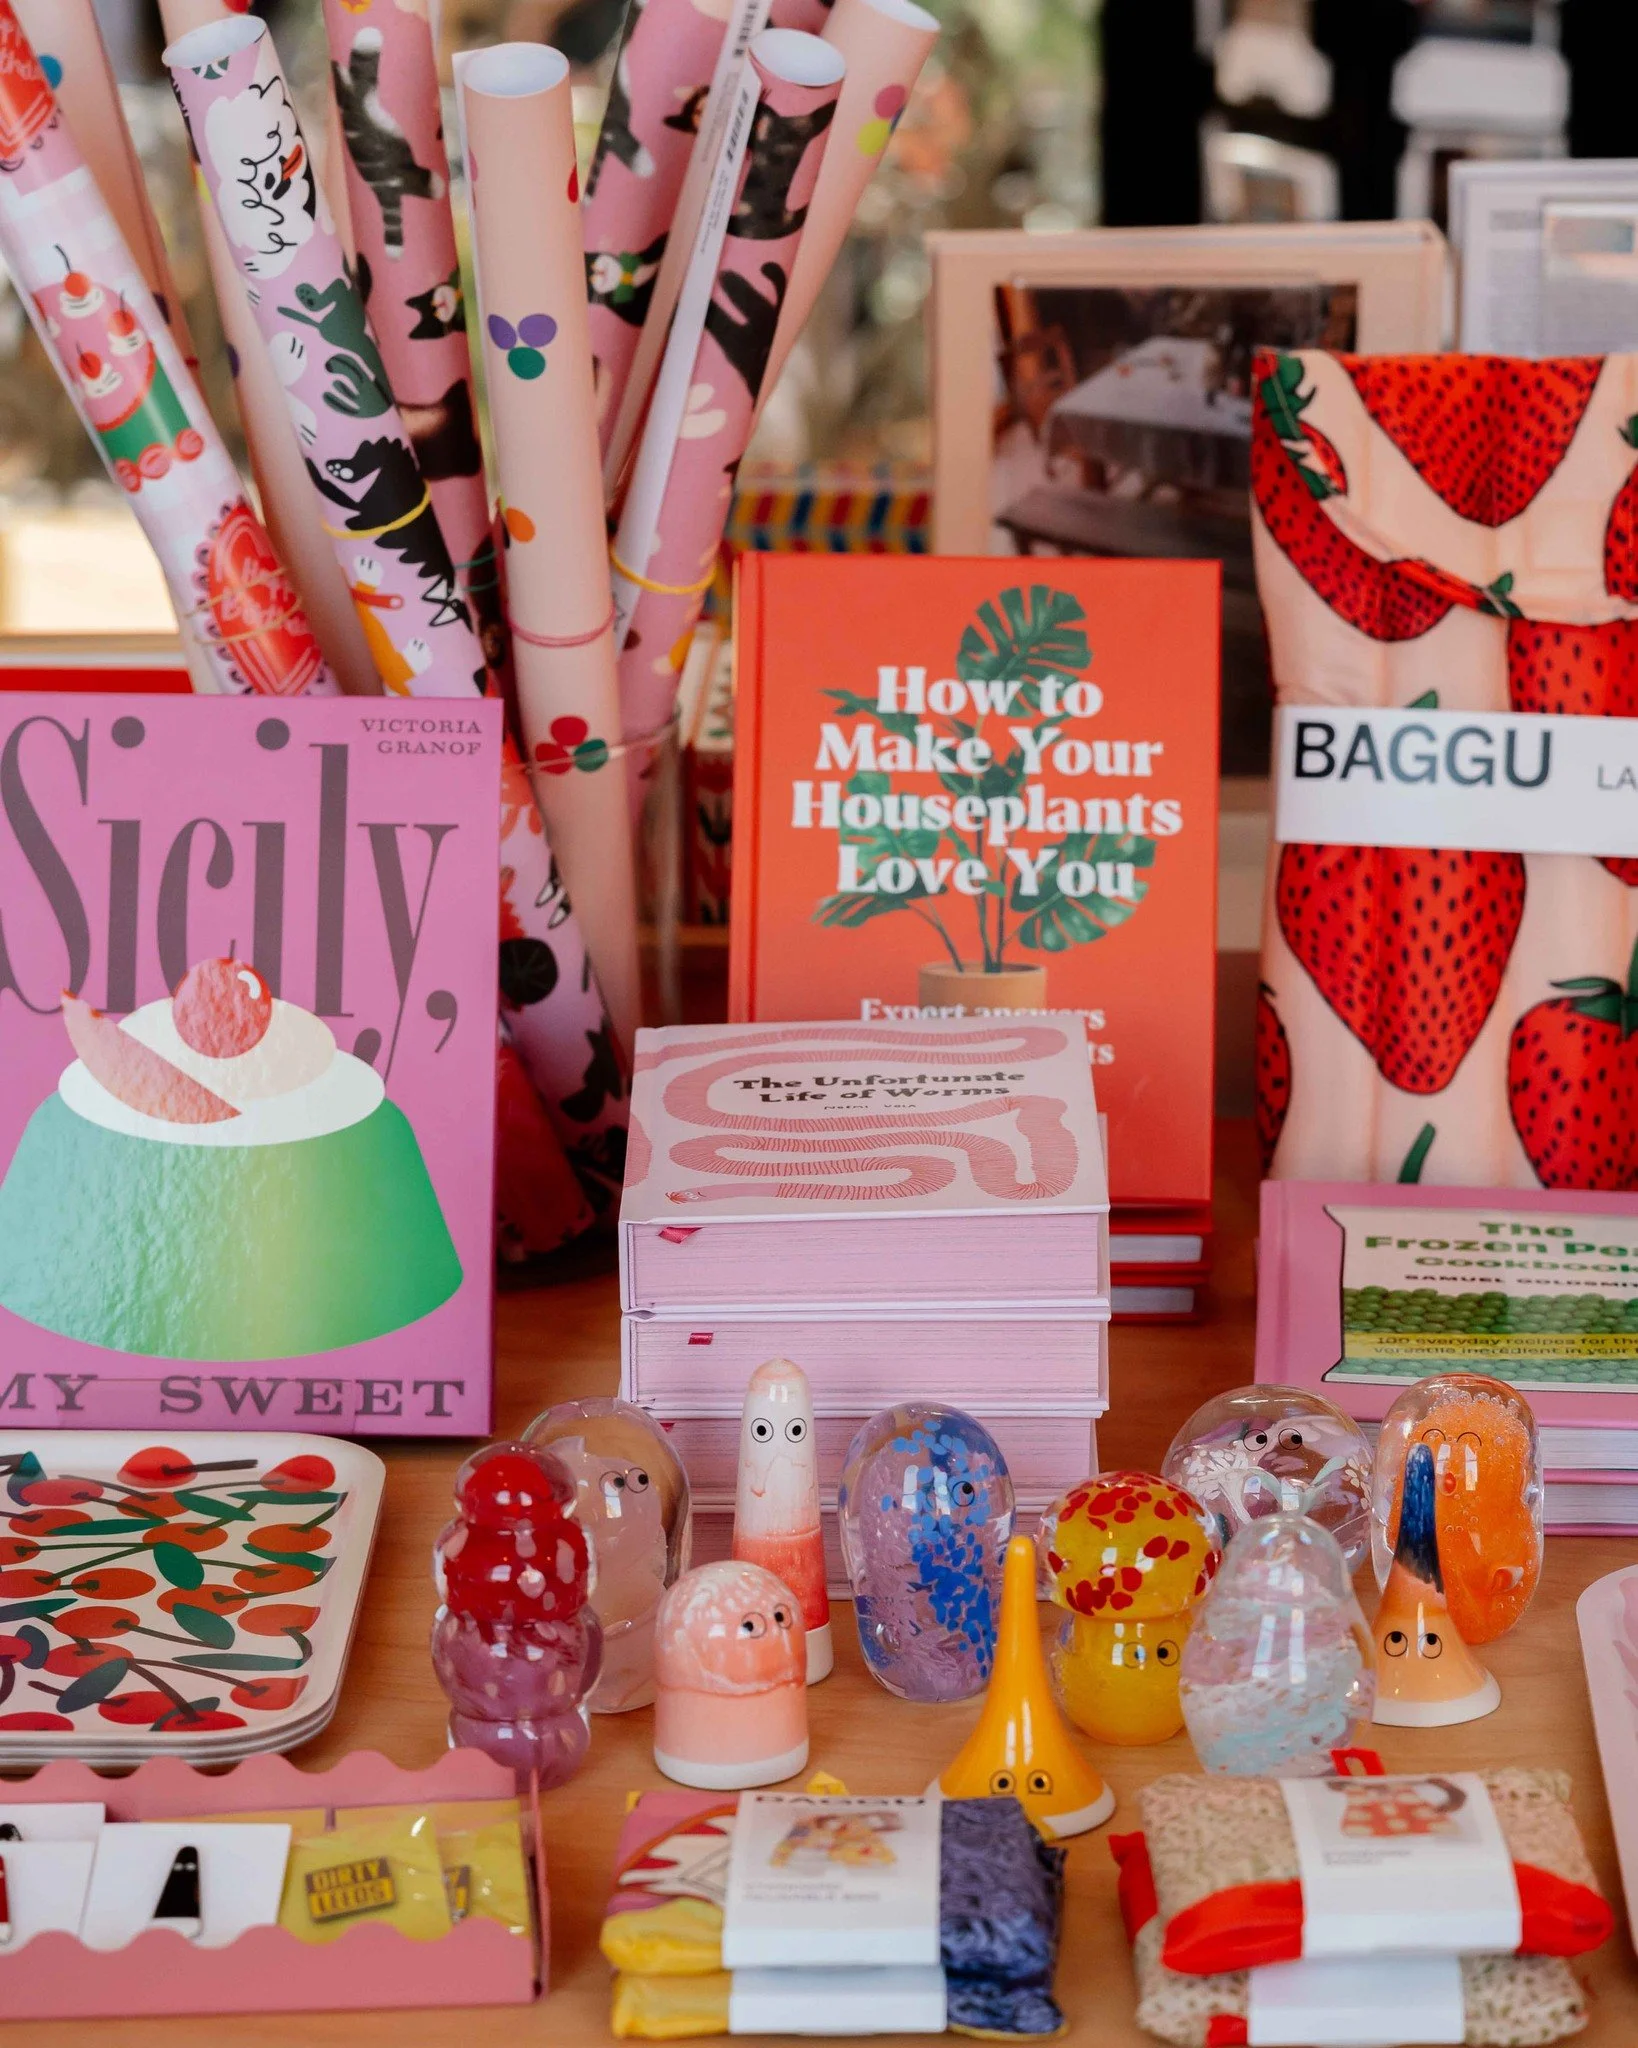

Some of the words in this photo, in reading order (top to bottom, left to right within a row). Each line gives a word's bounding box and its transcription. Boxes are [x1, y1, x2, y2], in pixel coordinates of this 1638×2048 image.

[876, 666, 1023, 716] How
[1039, 674, 1104, 718] to
[361, 719, 482, 734] VICTORIA
[377, 740, 482, 755] GRANOF
[814, 723, 994, 774] Make
[1008, 726, 1163, 777] Your
[1293, 721, 1553, 788] BAGGU
[791, 780, 1183, 847] Houseplants
[837, 844, 990, 896] Love
[1006, 848, 1136, 898] You
[0, 716, 459, 1083] Sicily,
[733, 1077, 802, 1090] The
[812, 1071, 1025, 1087] Unfortunate
[759, 1091, 827, 1103] Life
[840, 1089, 876, 1099] of
[884, 1087, 1010, 1098] Worms
[1479, 1222, 1573, 1238] The
[1365, 1236, 1548, 1254] Frozen
[1564, 1242, 1638, 1257] Pe
[1404, 1274, 1505, 1283] SAMUEL
[1374, 1346, 1456, 1354] versatile
[1462, 1347, 1557, 1355] ingredient
[1587, 1348, 1627, 1356] your
[1377, 1337, 1409, 1345] 100
[1416, 1337, 1500, 1346] everyday
[1506, 1338, 1576, 1346] recipes
[160, 1376, 465, 1417] SWEET
[313, 1861, 381, 1891] DIRTY
